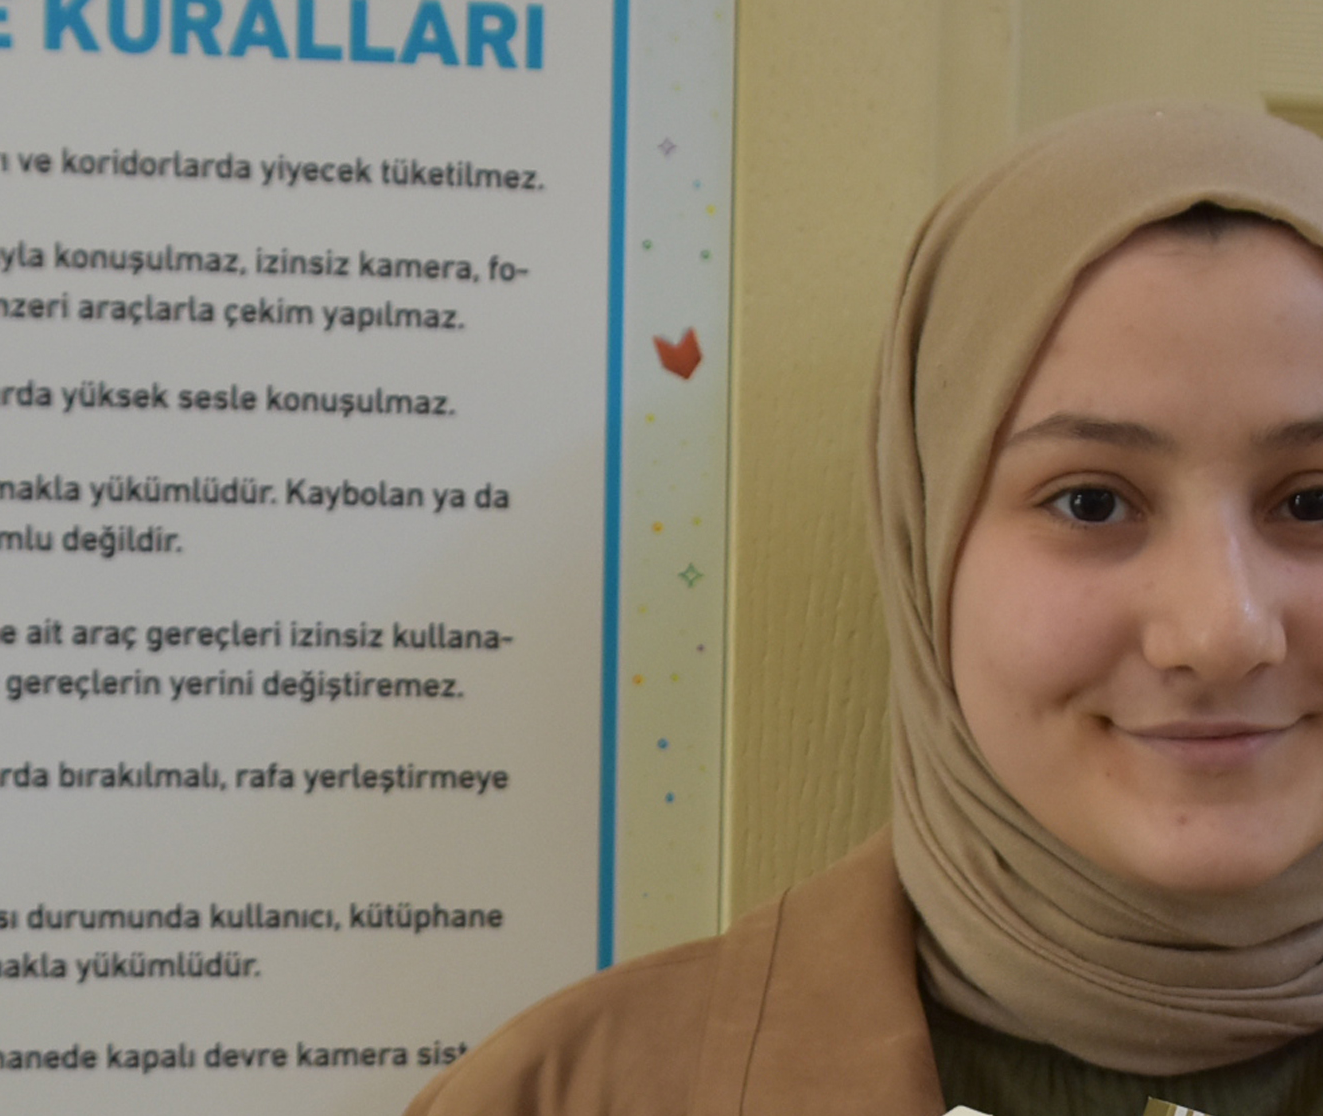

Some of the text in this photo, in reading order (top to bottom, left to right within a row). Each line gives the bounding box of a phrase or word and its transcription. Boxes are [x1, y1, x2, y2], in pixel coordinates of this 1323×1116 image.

[43, 0, 545, 71] KURALLARI
[17, 152, 54, 175] ve
[61, 147, 253, 182] koridorlarda
[260, 154, 373, 188] yiyecek
[380, 158, 545, 192] tüketilmez.
[54, 241, 247, 277] konuşulmaz,
[255, 246, 351, 278] izinsiz
[358, 250, 480, 284] kamera,
[487, 254, 530, 283] fo-
[77, 294, 216, 327] araçlarla
[223, 297, 315, 329] çekim
[322, 300, 465, 333] yapılmaz.
[61, 380, 170, 414] yüksek
[177, 383, 259, 413] sesle
[265, 384, 456, 419] konuşulmaz.
[89, 475, 277, 508] yükümlüdür.
[285, 478, 425, 513] Kaybolan
[432, 487, 467, 515] ya
[473, 482, 511, 511] da
[61, 525, 183, 561] değildir.
[25, 617, 64, 646] ait
[71, 624, 138, 651] araç
[145, 619, 282, 654] gereçleri
[290, 620, 384, 649] izinsiz
[392, 621, 514, 651] kullana-
[5, 668, 162, 703] gereçlerin
[168, 669, 255, 702] yerini
[261, 670, 465, 705] değiştiremez.
[58, 761, 228, 792] bırakılmalı,
[235, 761, 296, 790] rafa
[303, 762, 510, 796] yerleştirmeye
[26, 902, 202, 931] durumunda
[209, 902, 342, 932] kullanıcı,
[349, 902, 504, 935] kütüphane
[75, 951, 261, 985] yükümlüdür.
[106, 1042, 197, 1076] kapalı
[203, 1041, 289, 1069] devre
[296, 1041, 409, 1068] kamera
